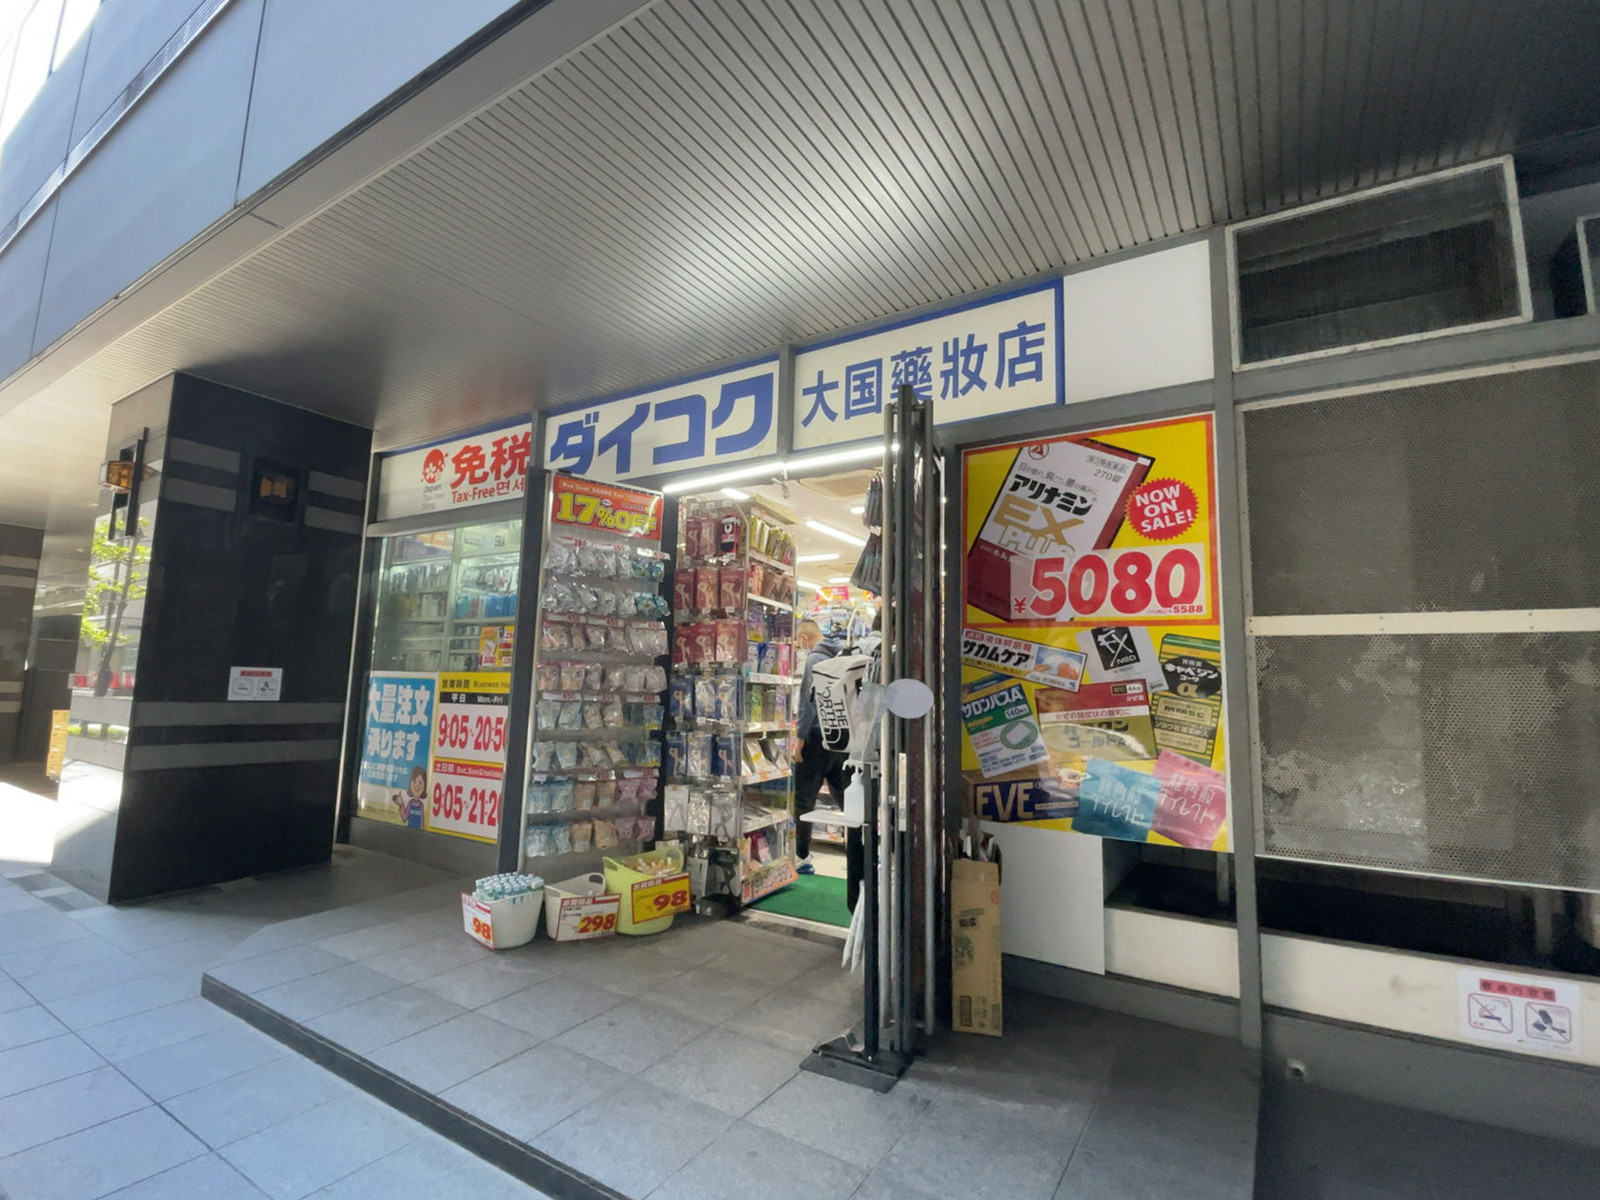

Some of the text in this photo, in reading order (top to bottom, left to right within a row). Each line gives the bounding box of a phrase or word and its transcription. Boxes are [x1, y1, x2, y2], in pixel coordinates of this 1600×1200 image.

[550, 372, 774, 475] ダイコク
[450, 431, 532, 489] 免税
[451, 486, 495, 504] Tax-Free
[1009, 473, 1093, 516] アリナミン
[1135, 484, 1180, 507] NOW
[556, 491, 658, 536] 17%OFF
[993, 493, 1085, 546] EX
[1140, 509, 1194, 533] SALE!
[1143, 499, 1178, 517] ON
[963, 640, 1031, 666] サカムケア
[1116, 654, 1137, 665] NEO
[366, 682, 431, 726] 大量注文
[451, 693, 466, 703] 平日
[833, 699, 849, 728] THE
[366, 726, 421, 762] 承ります
[976, 781, 1034, 823] EVE
[653, 889, 688, 911] 98
[472, 915, 492, 941] 98
[578, 913, 616, 934] 298
